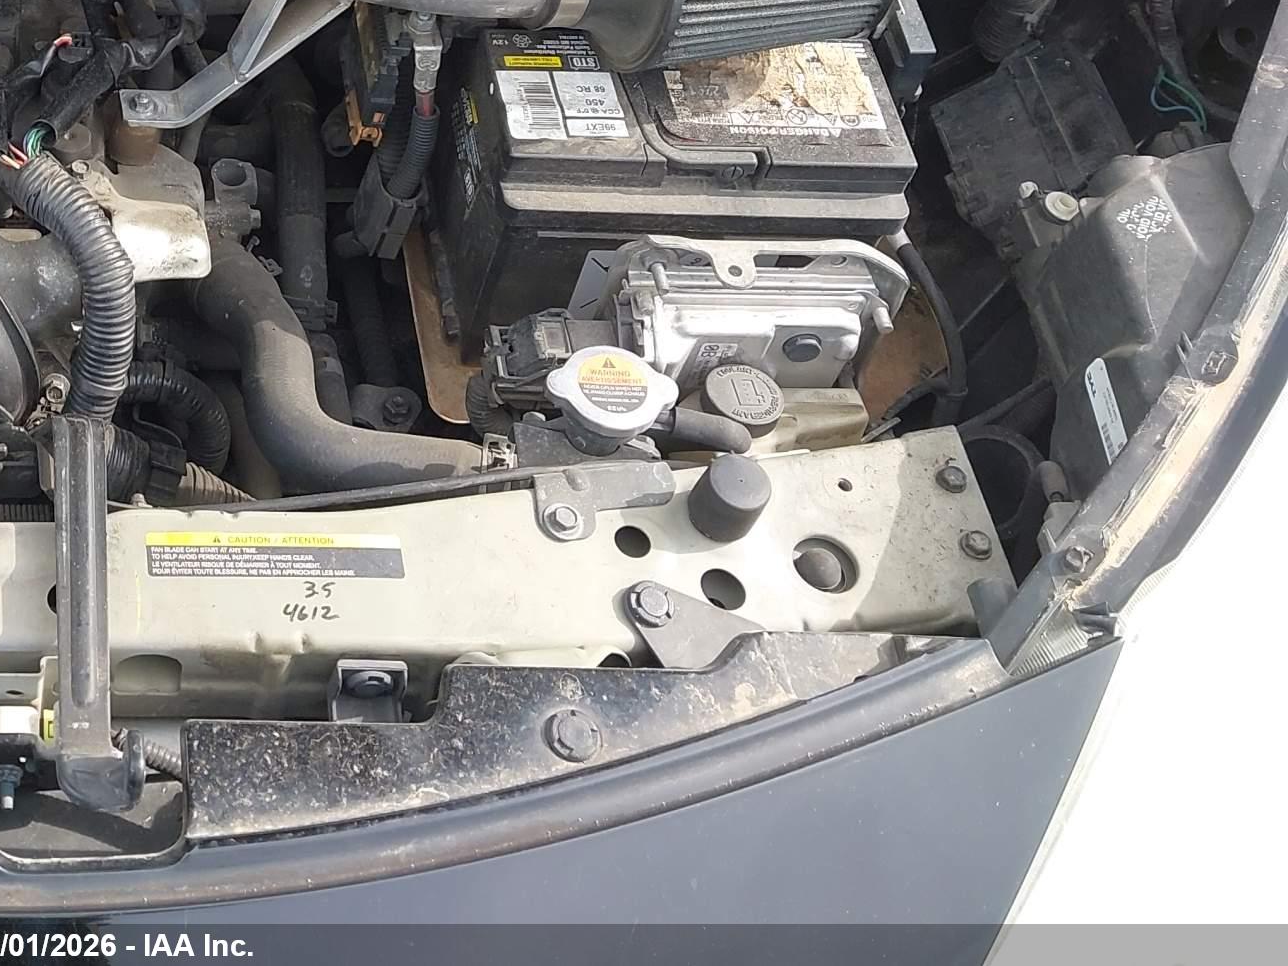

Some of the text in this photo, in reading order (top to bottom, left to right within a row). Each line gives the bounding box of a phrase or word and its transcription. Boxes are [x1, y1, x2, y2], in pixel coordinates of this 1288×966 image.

[576, 85, 591, 93] RC
[585, 98, 605, 106] 450
[227, 536, 271, 544] CAUTION
[281, 537, 334, 545] ATTENTION
[304, 581, 336, 599] 35
[282, 603, 340, 622] 4612
